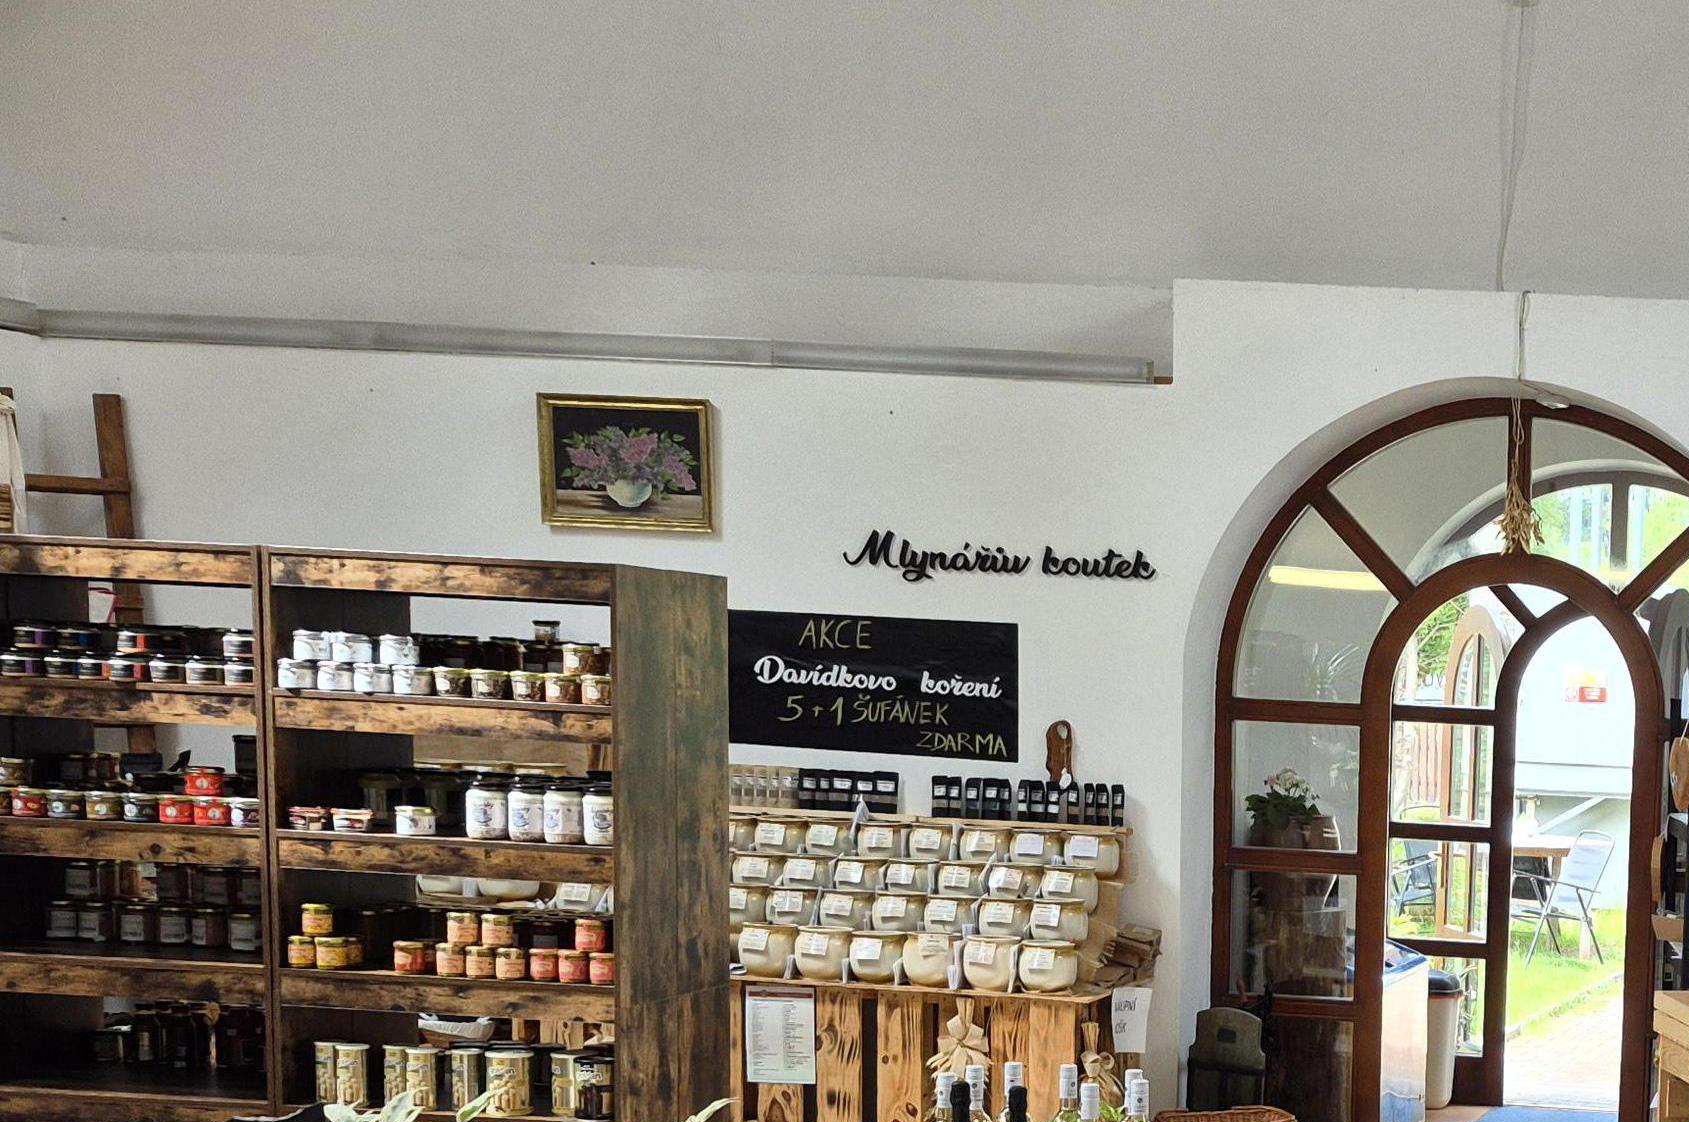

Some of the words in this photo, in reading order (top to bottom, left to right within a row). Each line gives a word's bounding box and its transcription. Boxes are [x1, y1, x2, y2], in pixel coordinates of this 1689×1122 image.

[1041, 545, 1158, 581] koutek
[798, 618, 873, 650] AKCE
[754, 654, 897, 691] Davídkovo
[920, 670, 1002, 699] koření
[850, 694, 949, 726] ŠUFÁNEK
[915, 731, 1007, 757] ZDARMA
